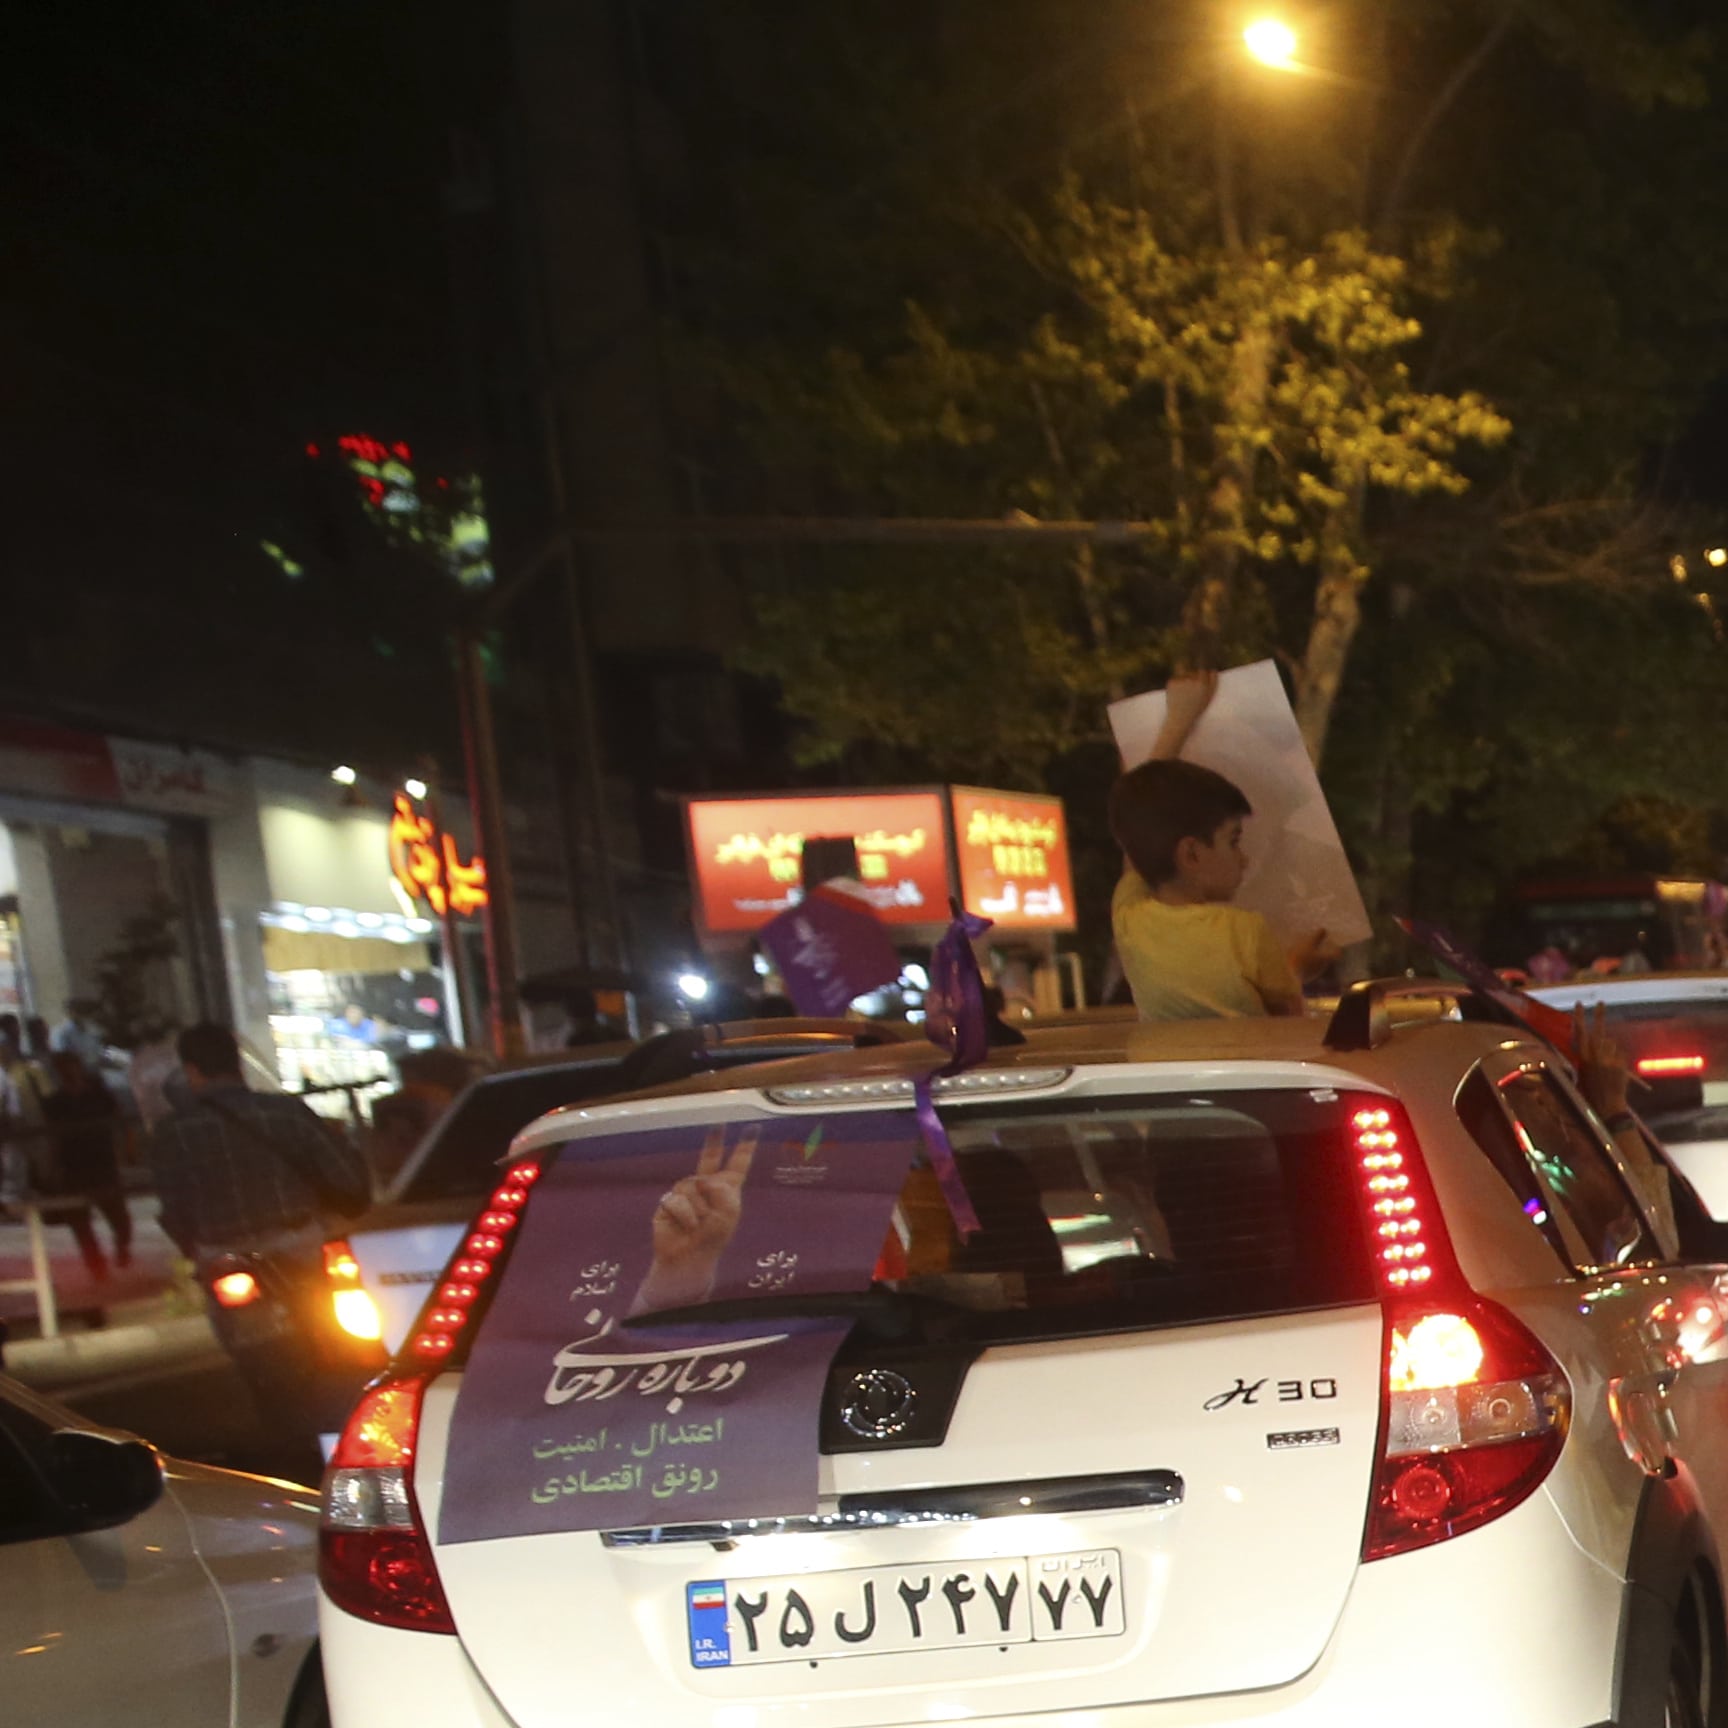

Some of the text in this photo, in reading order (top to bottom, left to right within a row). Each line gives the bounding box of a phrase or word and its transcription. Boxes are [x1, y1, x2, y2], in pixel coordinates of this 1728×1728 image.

[580, 1260, 620, 1278] برای
[756, 1250, 797, 1269] برای
[545, 1308, 790, 1414] دوباره روحانی
[533, 1417, 724, 1460] اعتدال امنیت
[531, 1463, 719, 1503] رونق اقتصادی
[695, 1650, 729, 1662] IRAN
